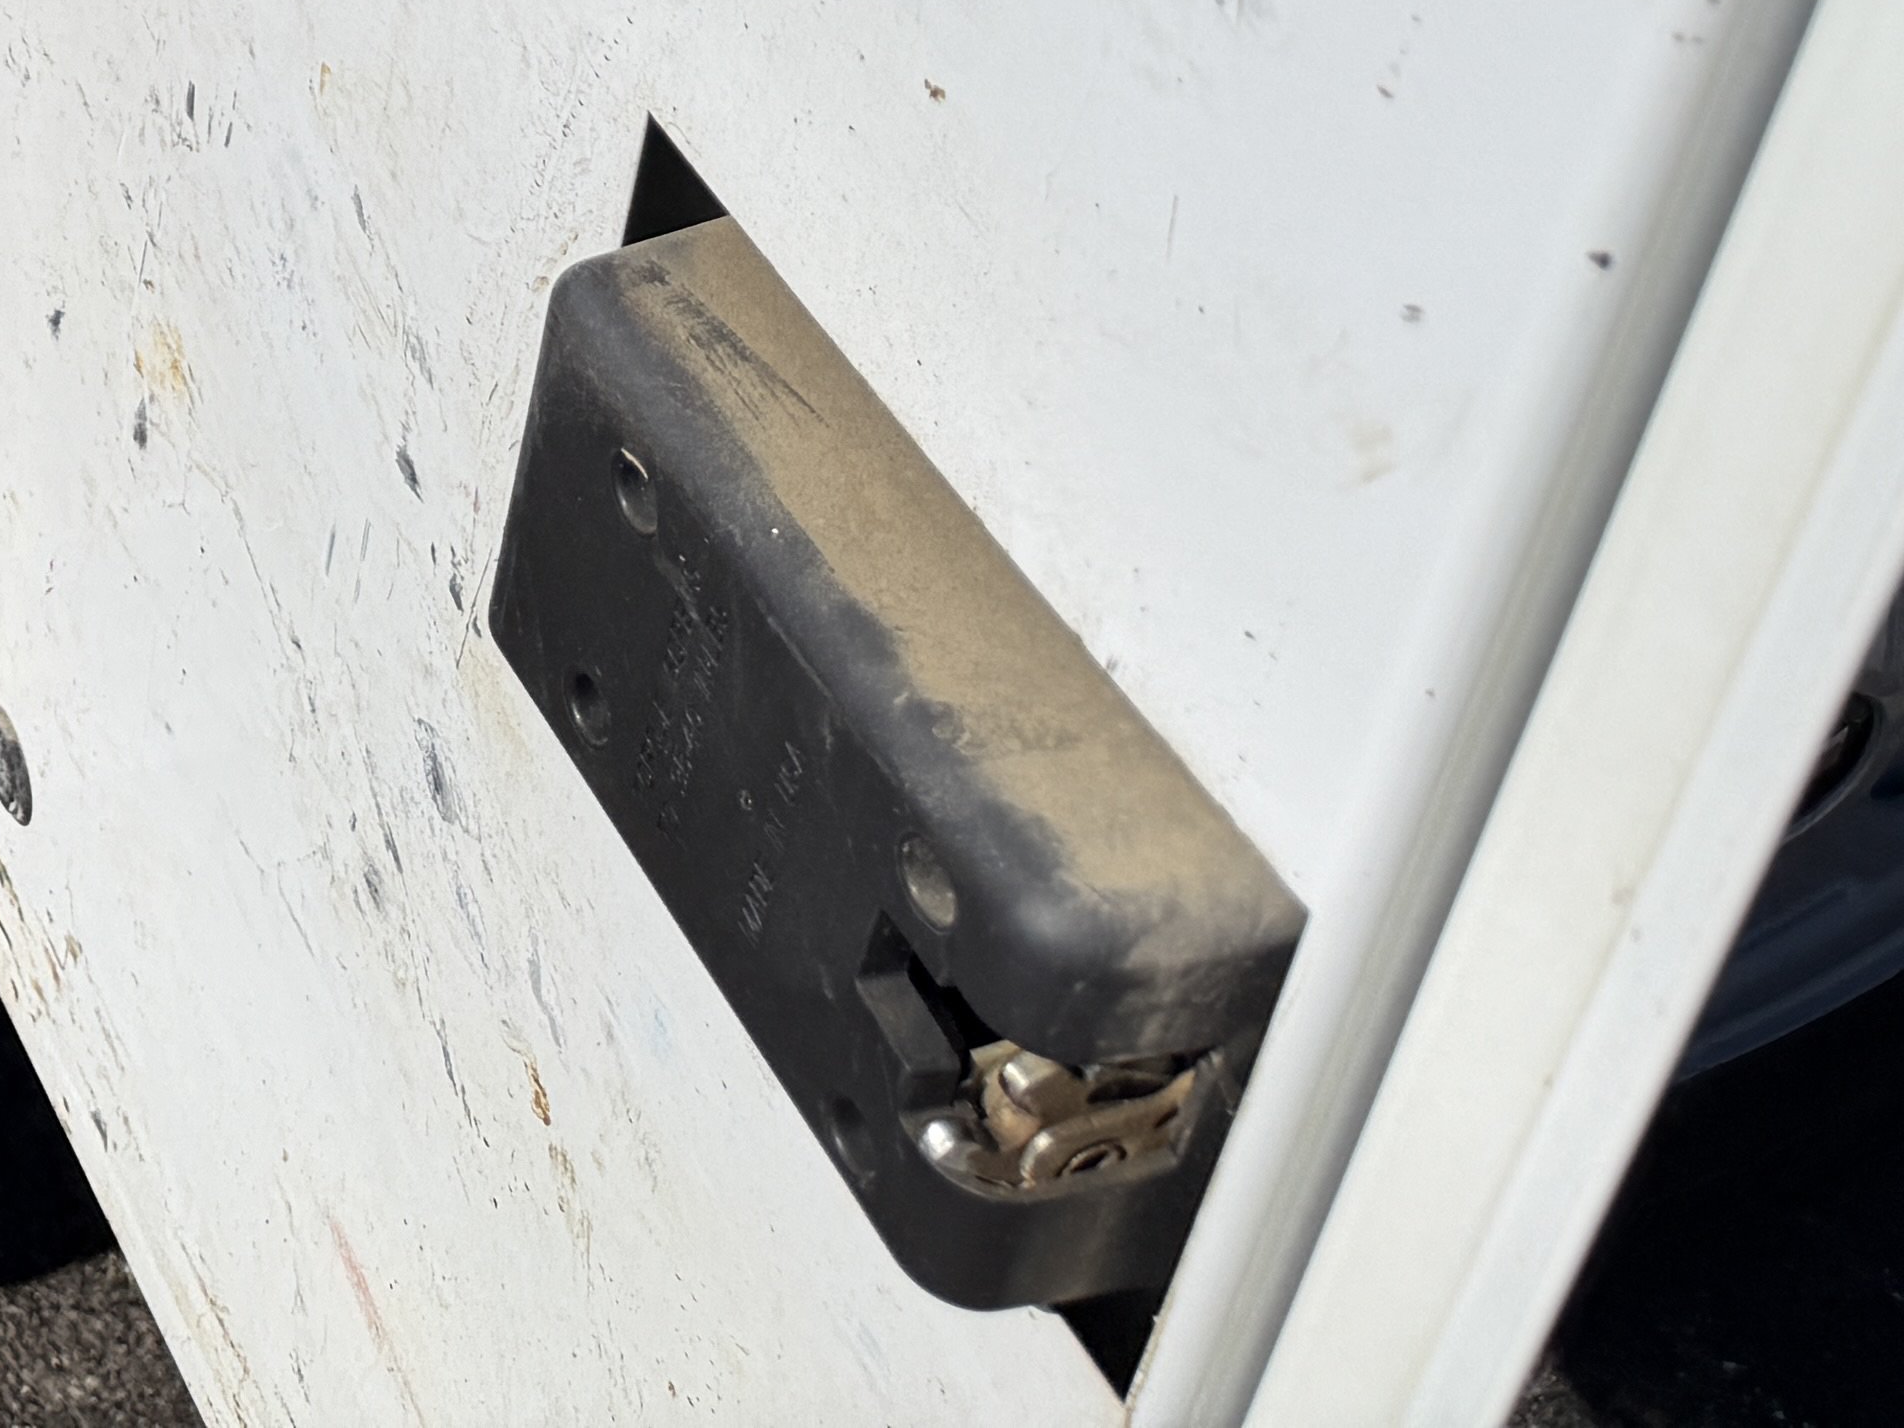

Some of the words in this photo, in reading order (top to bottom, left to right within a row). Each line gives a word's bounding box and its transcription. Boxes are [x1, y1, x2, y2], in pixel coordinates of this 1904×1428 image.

[774, 740, 805, 807] USA
[763, 808, 786, 853] IN
[738, 861, 774, 950] MADE
